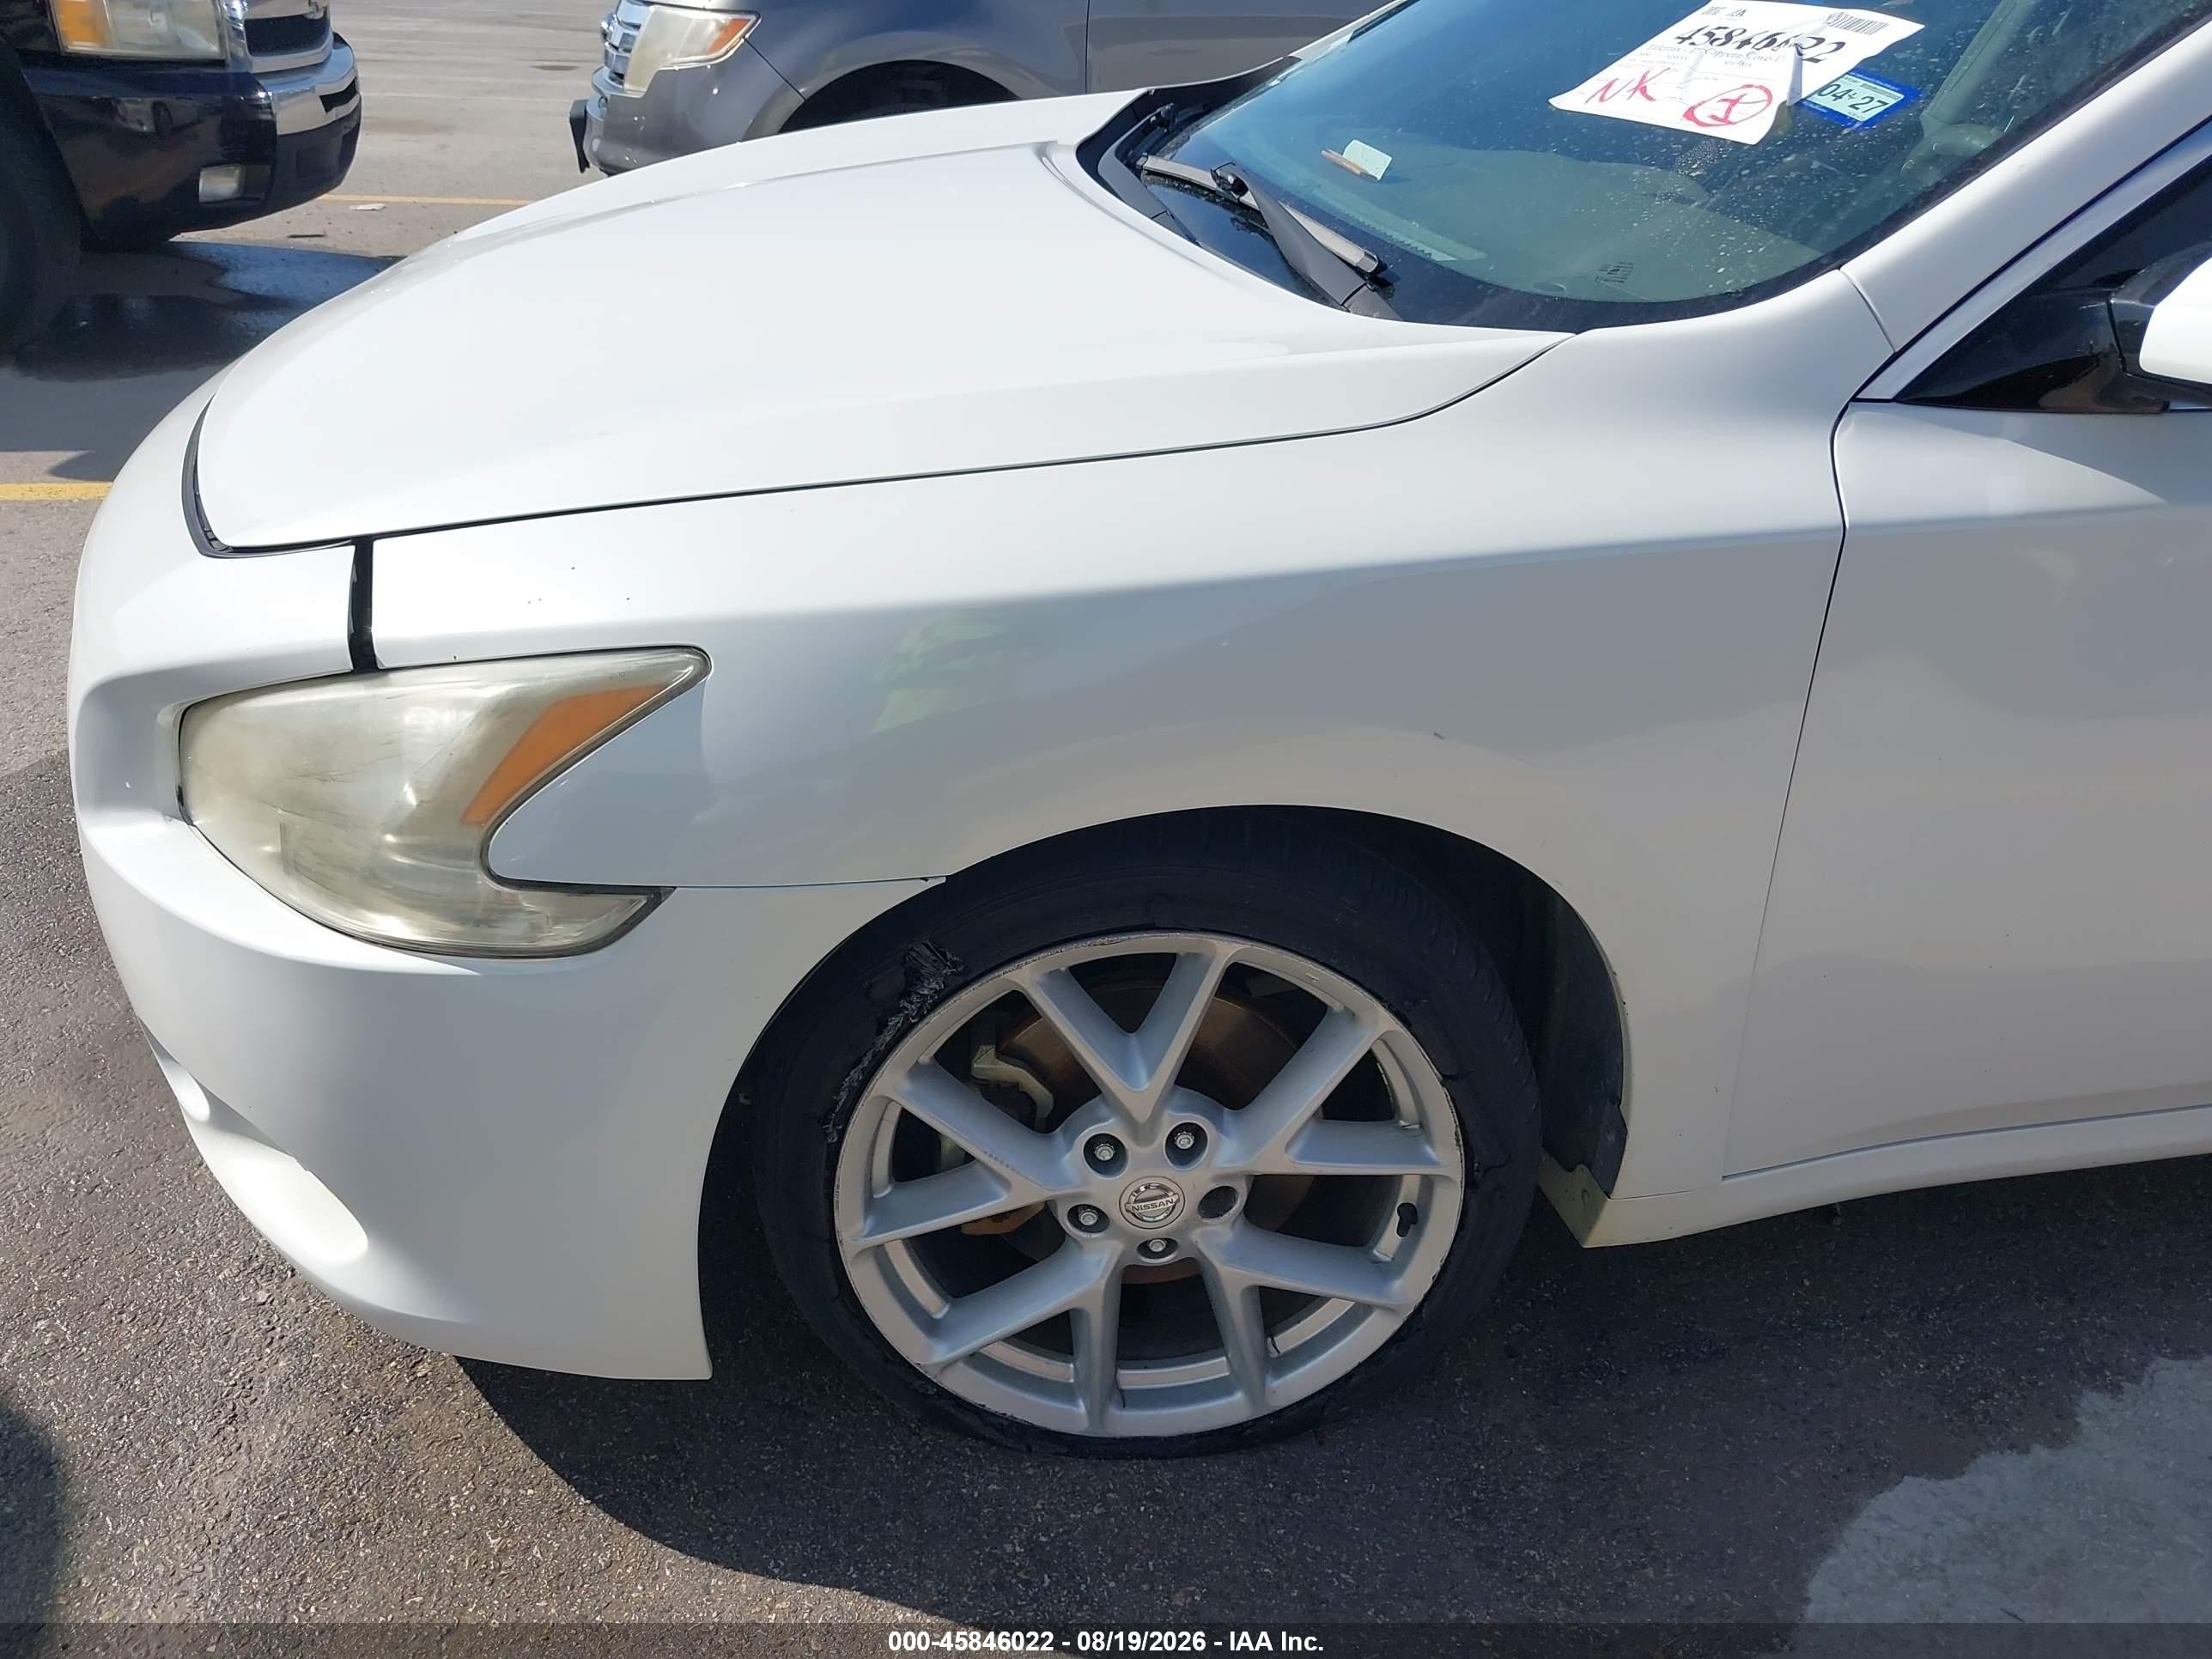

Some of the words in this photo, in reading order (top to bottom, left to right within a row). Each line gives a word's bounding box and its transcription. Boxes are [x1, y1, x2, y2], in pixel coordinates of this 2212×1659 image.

[1817, 83, 1853, 102] 04
[1848, 95, 1890, 113] 27
[1131, 1198, 1174, 1212] NISSAN
